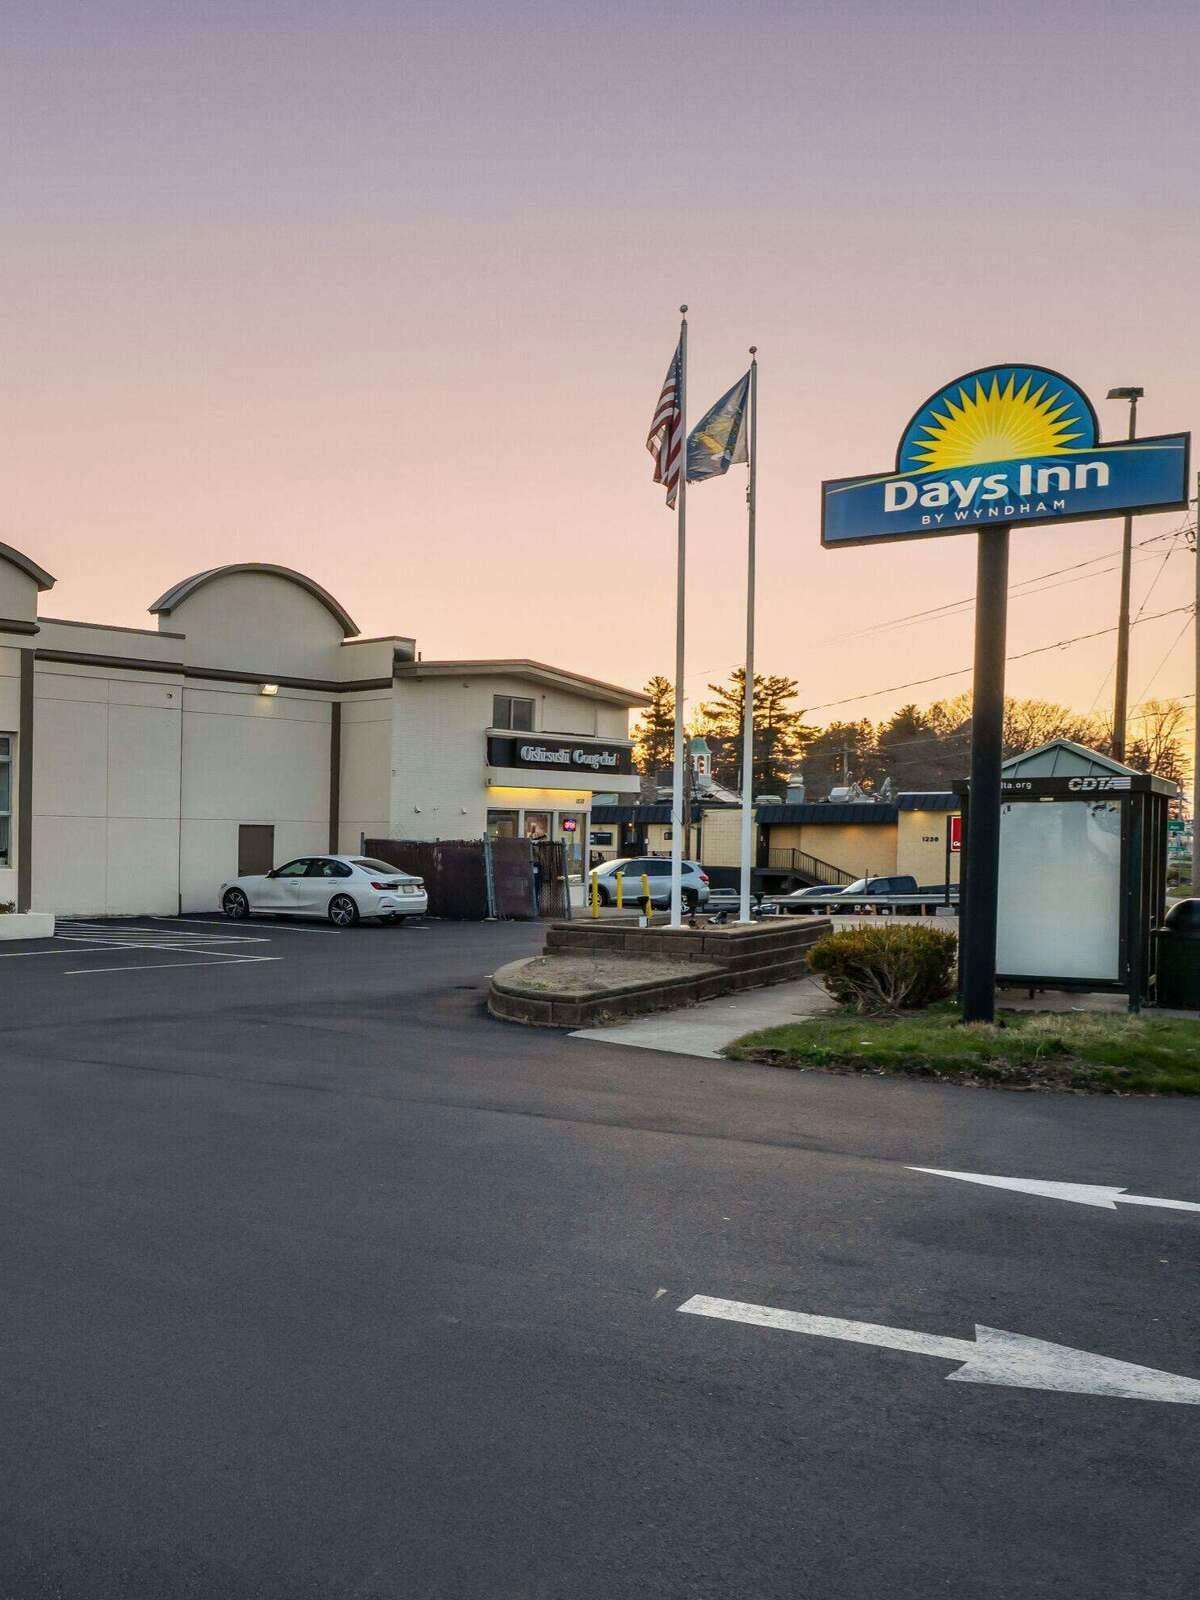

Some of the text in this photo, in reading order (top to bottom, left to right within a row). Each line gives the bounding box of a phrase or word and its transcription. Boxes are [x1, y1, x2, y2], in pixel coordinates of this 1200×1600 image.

[883, 461, 1110, 514] Days Inn
[921, 499, 1066, 525] BY WYNDHAM
[1067, 777, 1126, 791] CDTA
